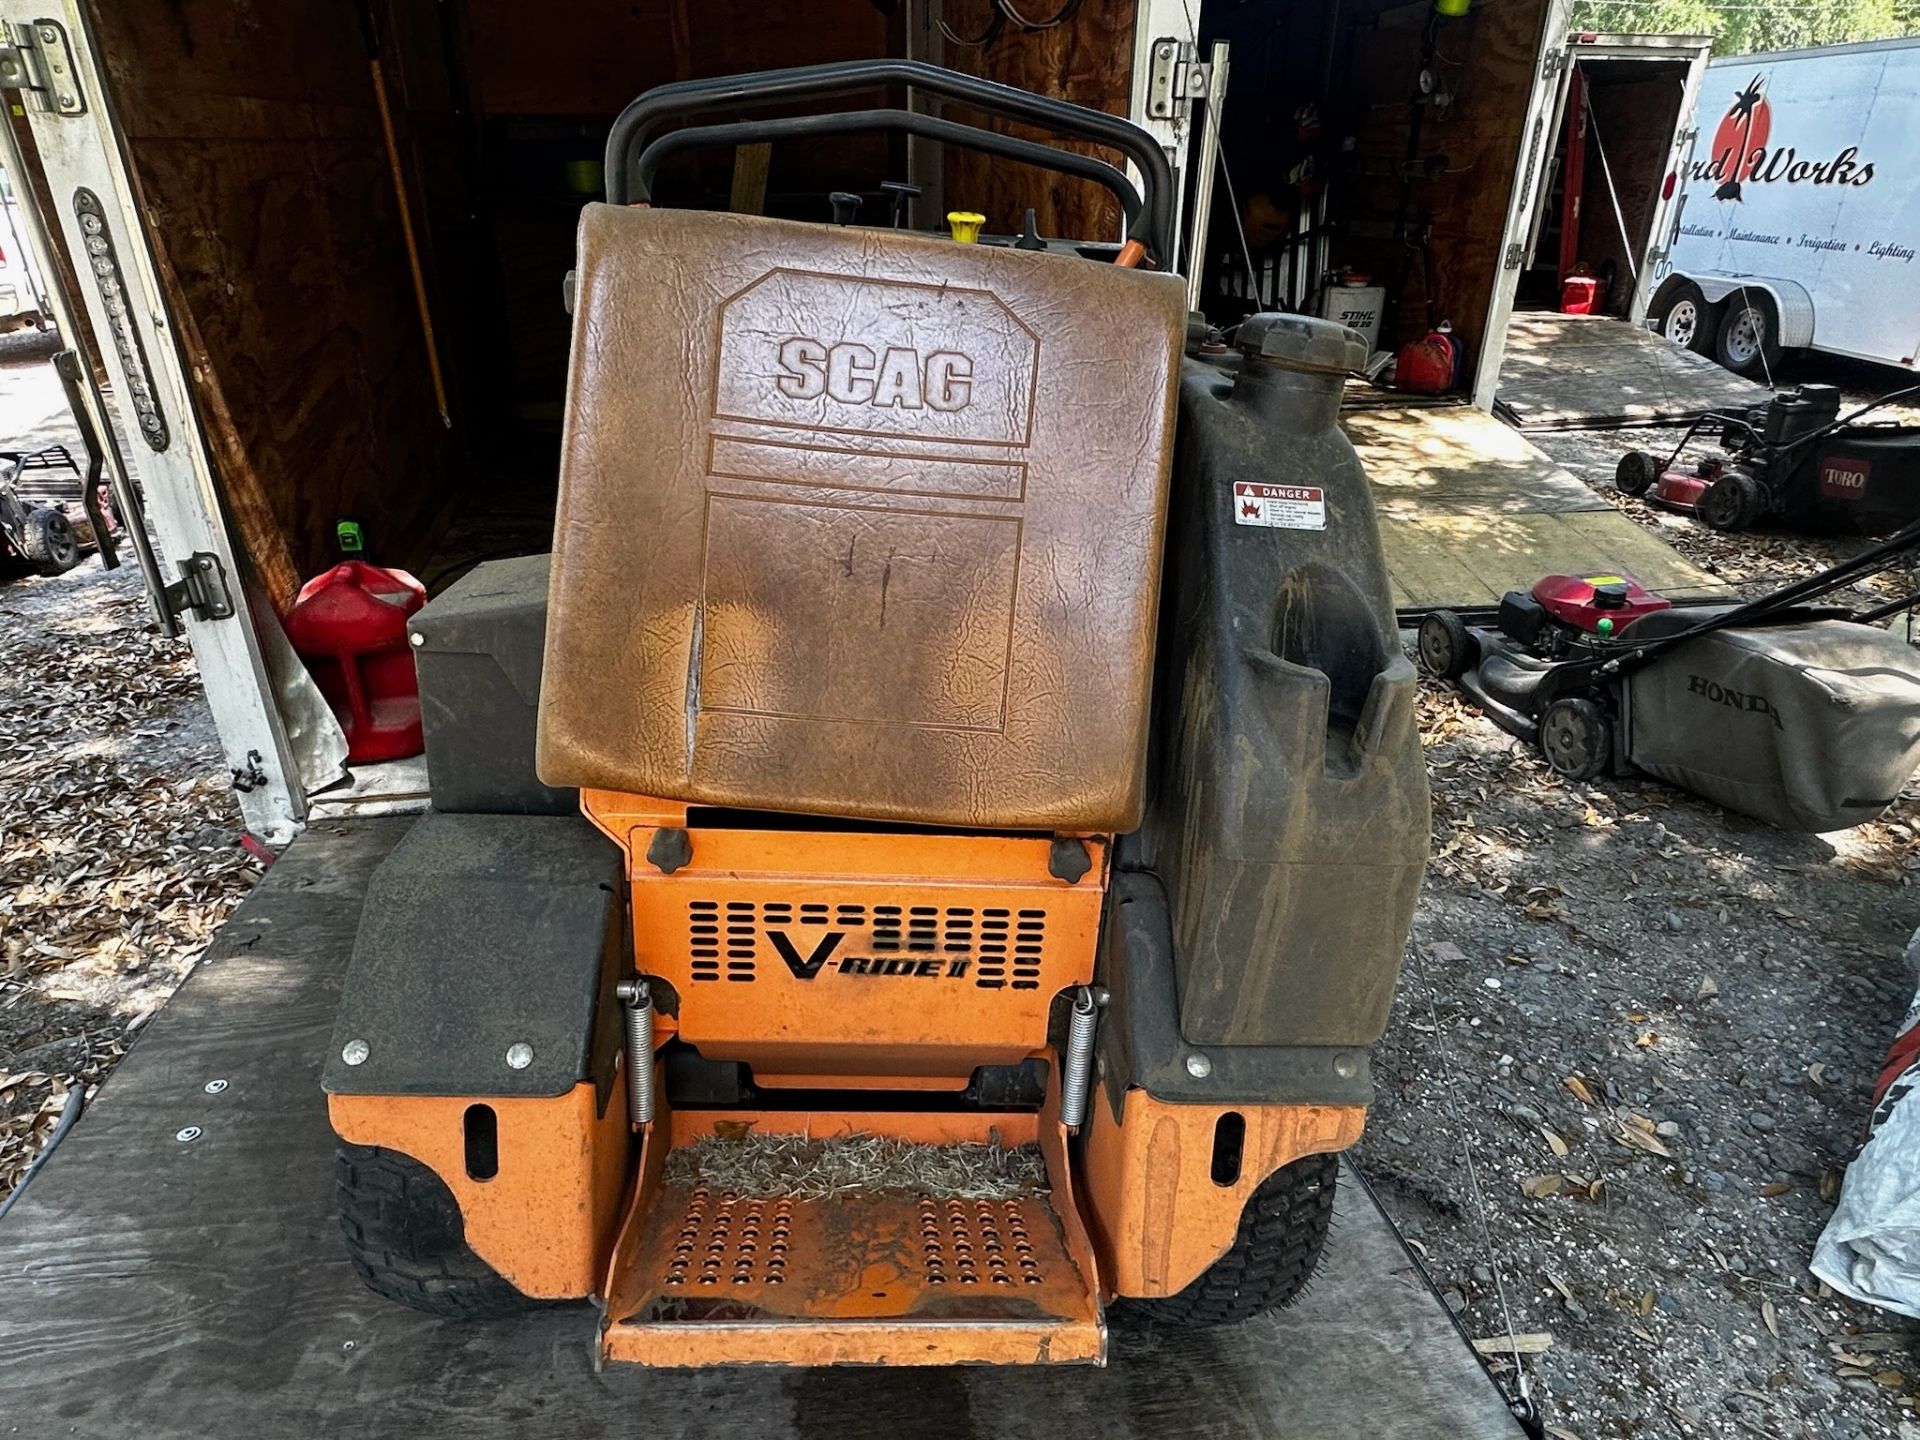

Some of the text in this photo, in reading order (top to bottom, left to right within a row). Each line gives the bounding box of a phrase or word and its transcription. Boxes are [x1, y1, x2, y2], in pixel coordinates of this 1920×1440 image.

[1688, 146, 1875, 186] rd Works
[1724, 227, 1780, 245] Maintenance
[1796, 234, 1847, 253] Irrigation
[1867, 241, 1915, 263] Lighting
[1340, 311, 1376, 320] STIHL
[777, 336, 975, 413] SCAG
[1262, 487, 1310, 499] DANGER
[1825, 468, 1865, 488] TORO
[1687, 674, 1784, 731] HONDA
